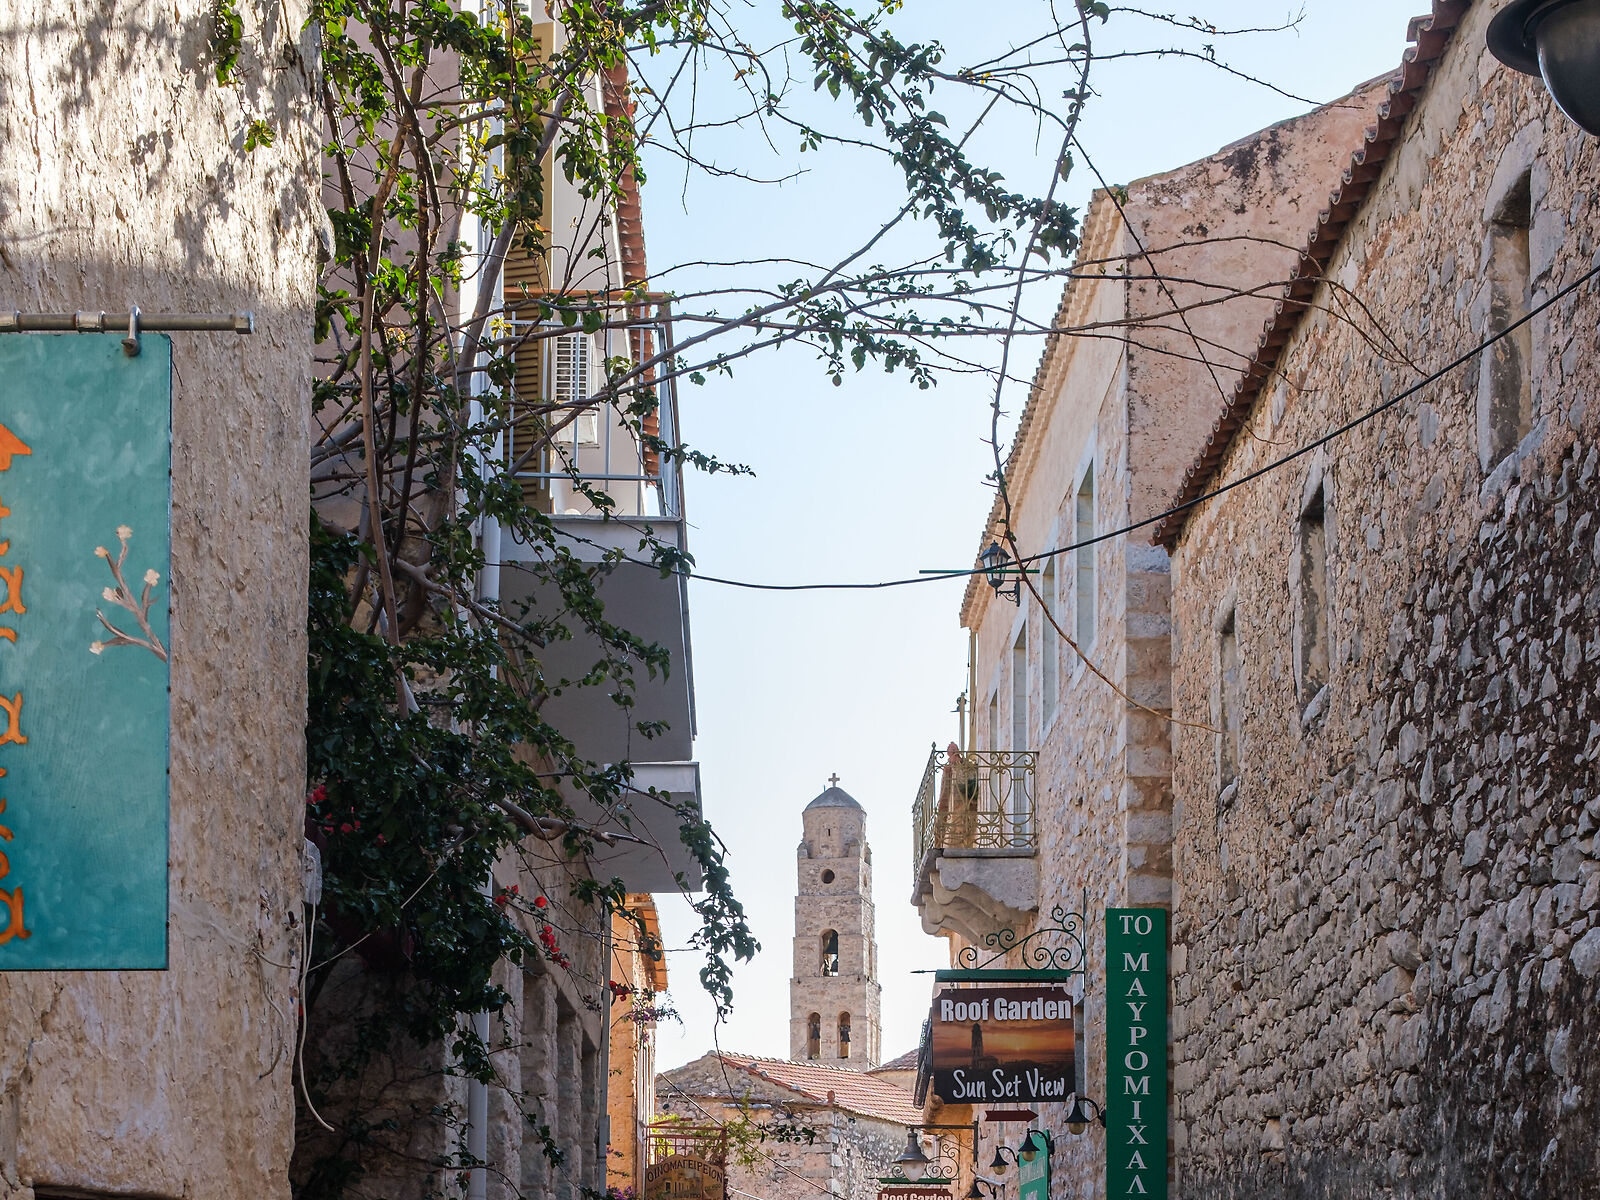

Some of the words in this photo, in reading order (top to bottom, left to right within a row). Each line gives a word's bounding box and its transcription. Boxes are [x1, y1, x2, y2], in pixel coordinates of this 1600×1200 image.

[940, 998, 989, 1022] Roof
[994, 997, 1072, 1020] Garden
[952, 1069, 987, 1099] Sun
[991, 1068, 1022, 1097] Set
[1026, 1067, 1065, 1097] View
[647, 1159, 723, 1183] ΟΙΝΟΜΑΓΕΙΡΕΙΟΝ
